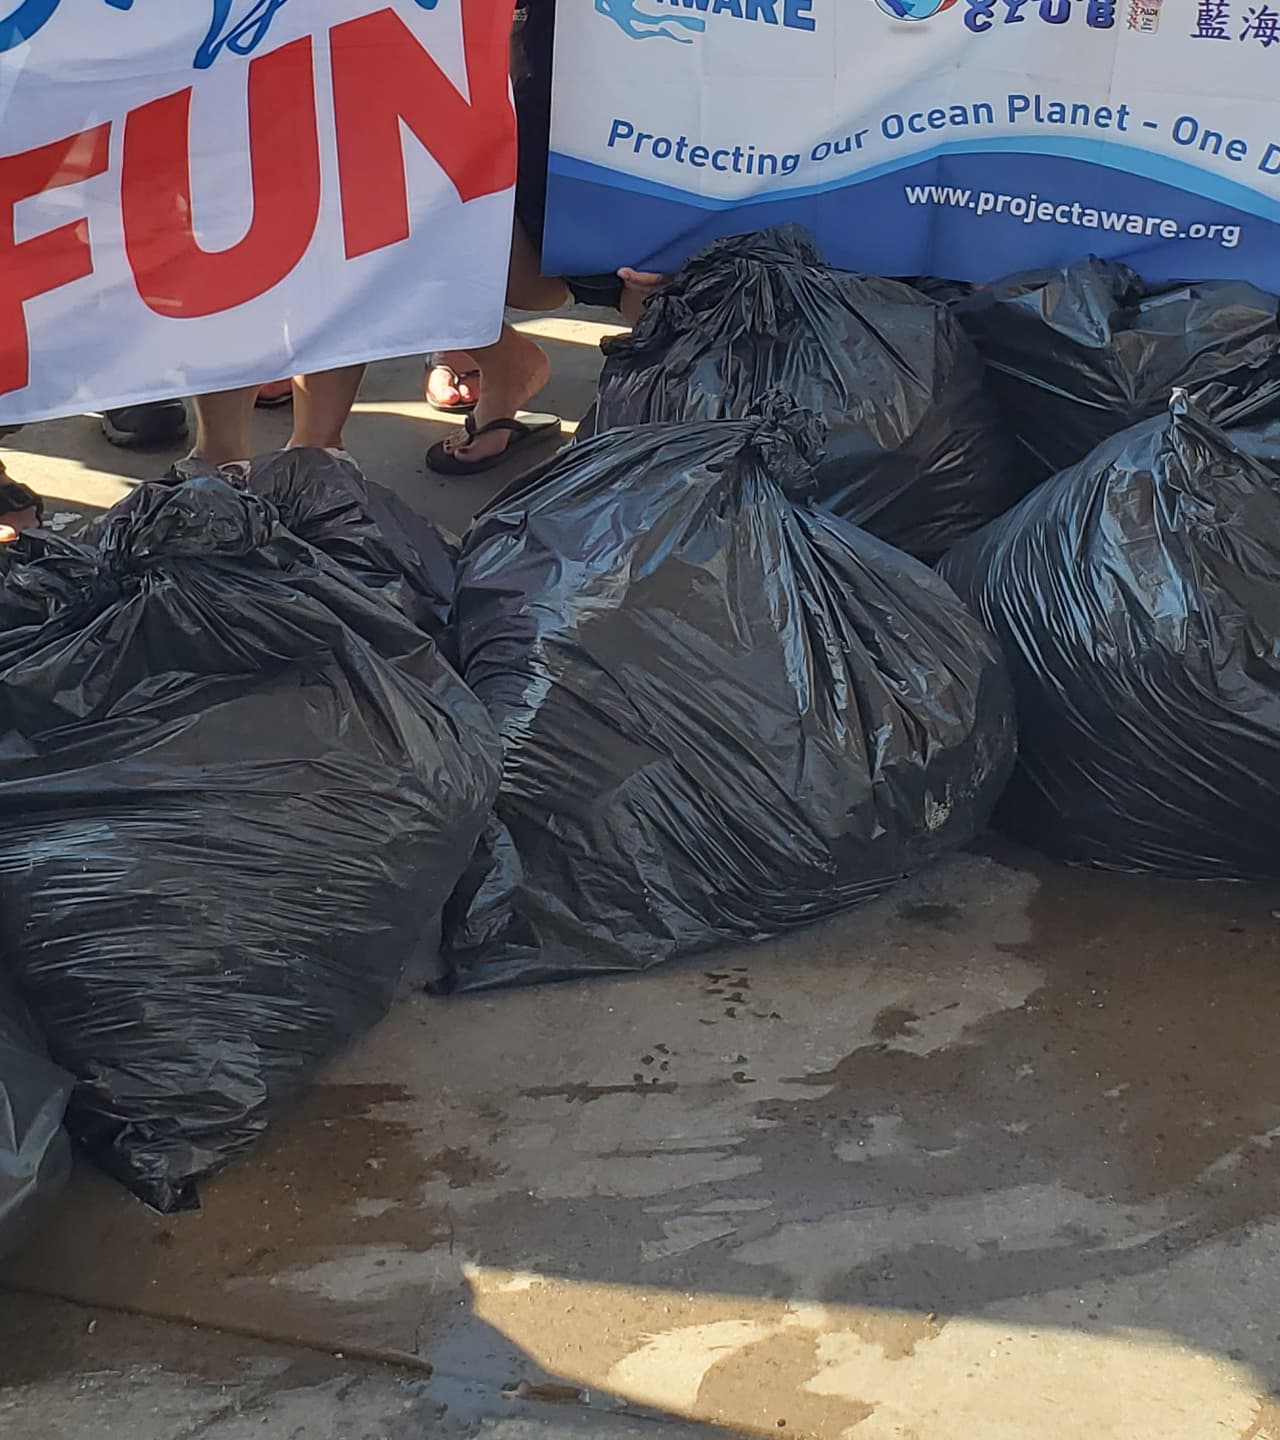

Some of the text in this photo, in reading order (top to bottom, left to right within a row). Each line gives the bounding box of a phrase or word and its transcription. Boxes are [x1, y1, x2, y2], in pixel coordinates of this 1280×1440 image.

[607, 118, 801, 177] Protecting
[809, 127, 871, 162] our
[880, 99, 995, 141] Ocean
[1007, 94, 1129, 133] Planet
[1171, 115, 1249, 163] One
[905, 183, 1241, 248] www.projectaware.org
